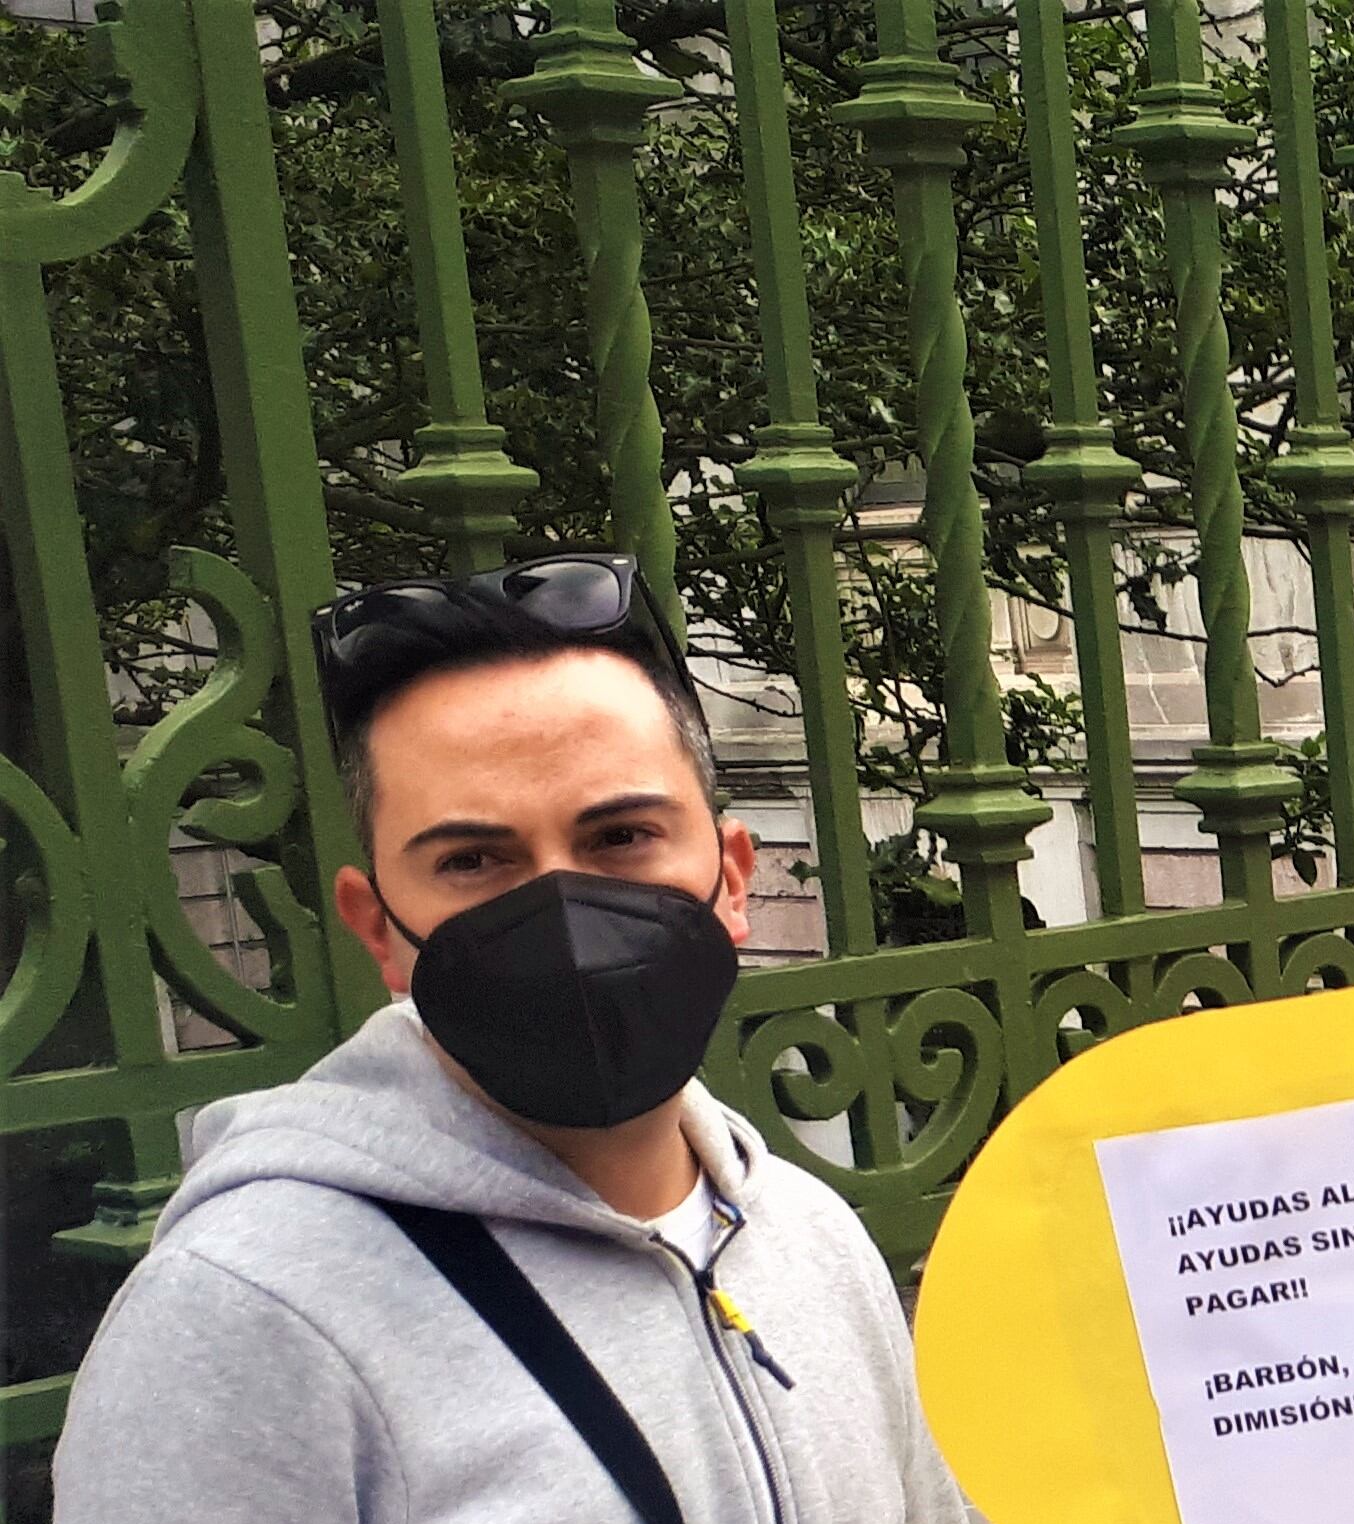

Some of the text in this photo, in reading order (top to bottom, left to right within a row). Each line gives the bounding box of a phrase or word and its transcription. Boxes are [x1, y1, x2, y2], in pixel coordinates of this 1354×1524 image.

[1167, 1190, 1311, 1238] ¡¡AYUDAS
[1177, 1235, 1303, 1275] AYUDAS
[1185, 1277, 1309, 1317] PAGAR!!
[1204, 1354, 1350, 1401] ¡BARBÓN,
